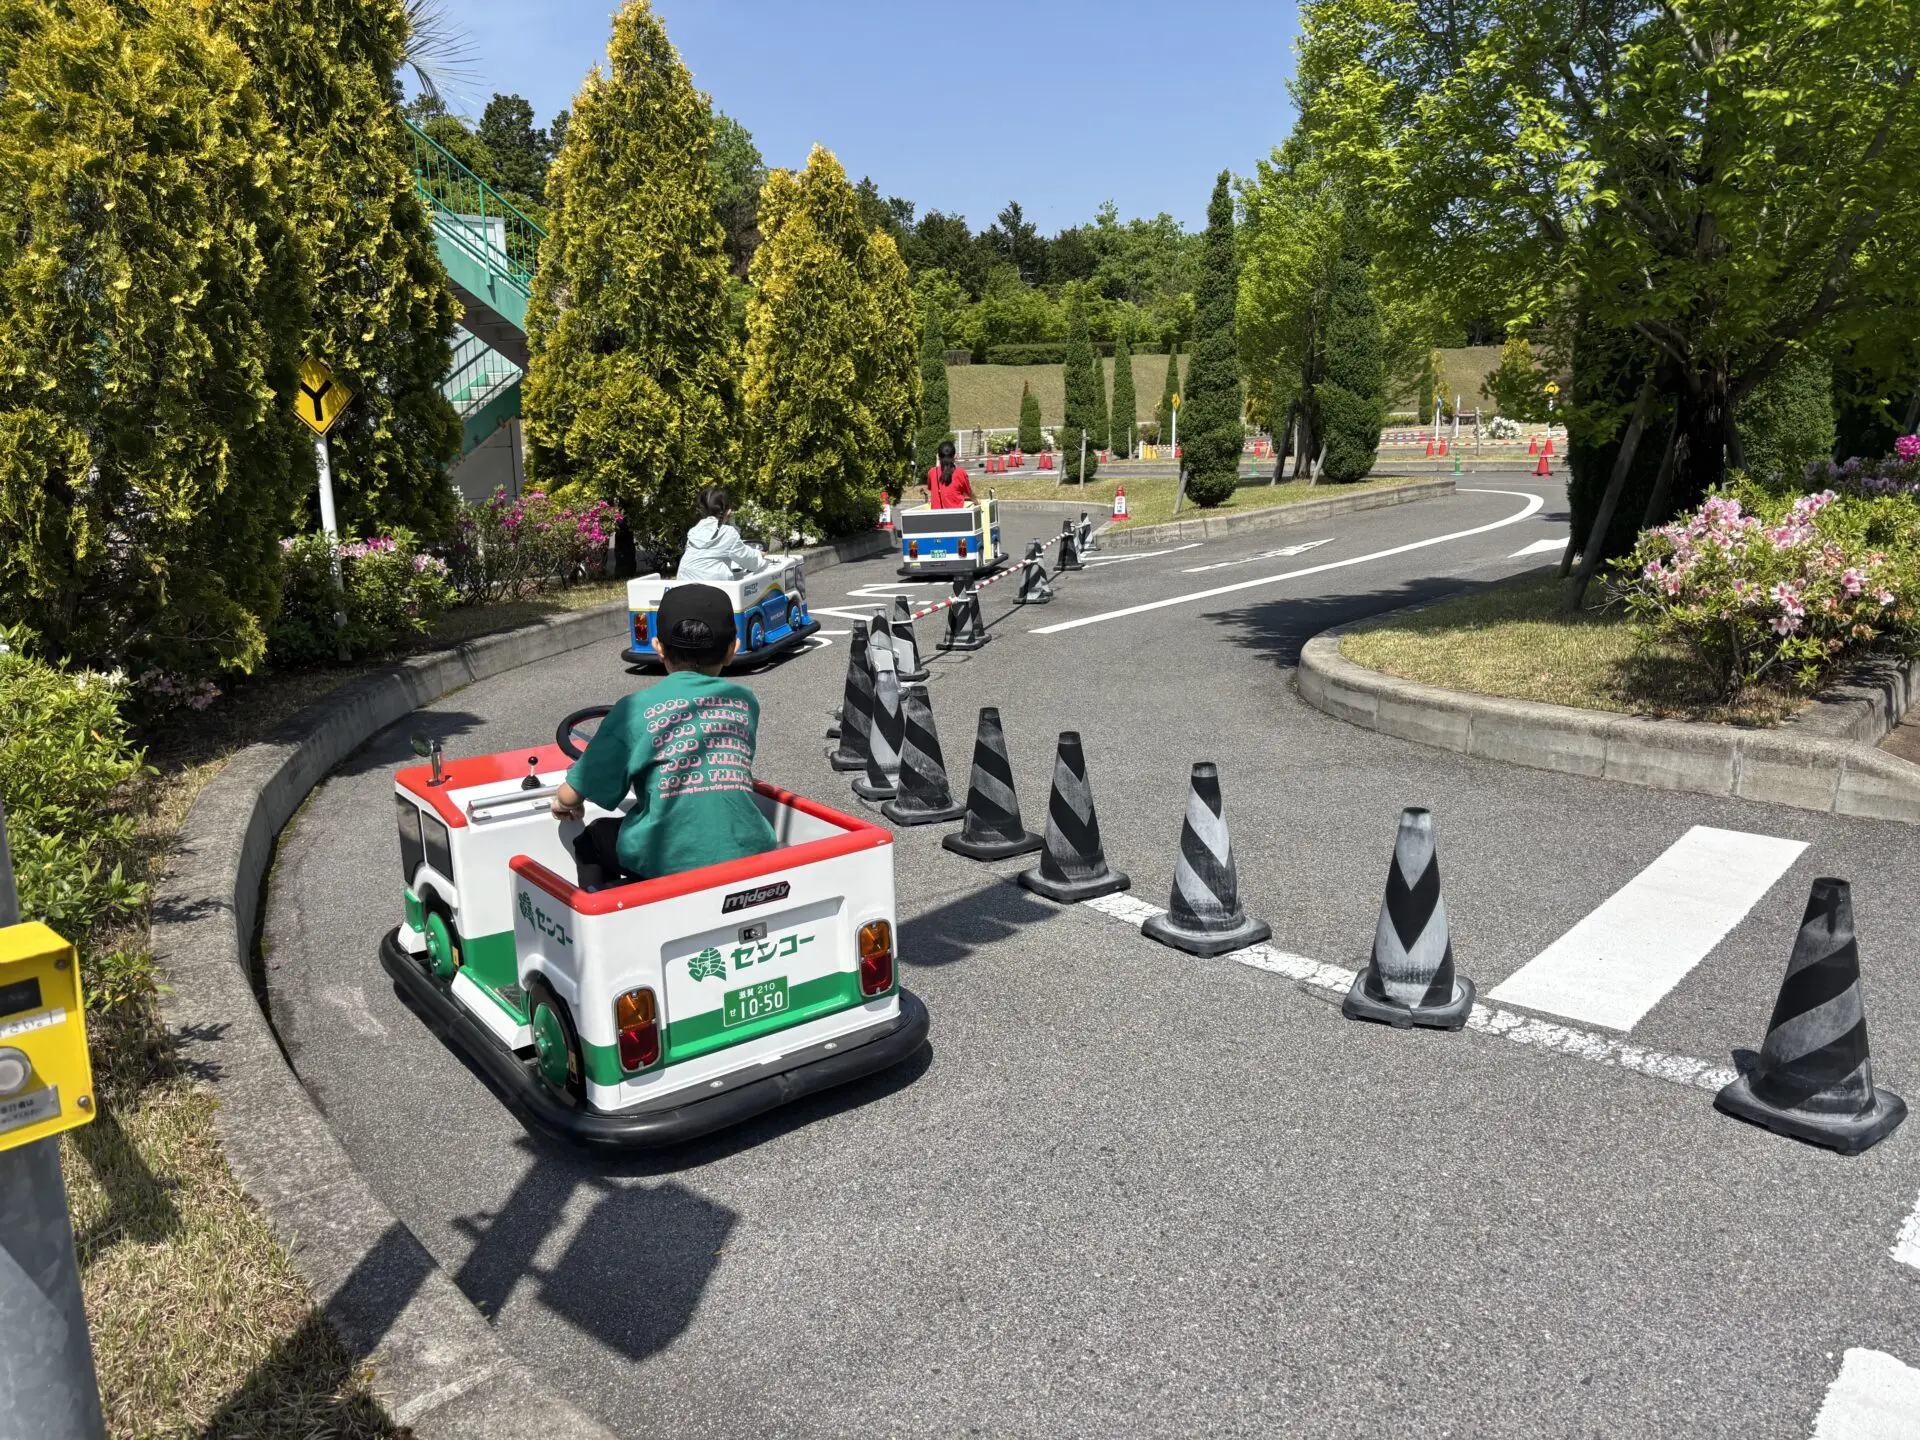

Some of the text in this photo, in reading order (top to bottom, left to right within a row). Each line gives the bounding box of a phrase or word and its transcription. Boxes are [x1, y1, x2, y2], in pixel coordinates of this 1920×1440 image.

[644, 699, 689, 719] GOOD
[647, 711, 693, 733] GOOD
[652, 724, 696, 747] GOOD
[658, 771, 704, 791] GOOD
[535, 906, 574, 947] センコー
[730, 933, 816, 971] センコー
[757, 982, 776, 994] 210
[740, 991, 783, 1019] 10-50
